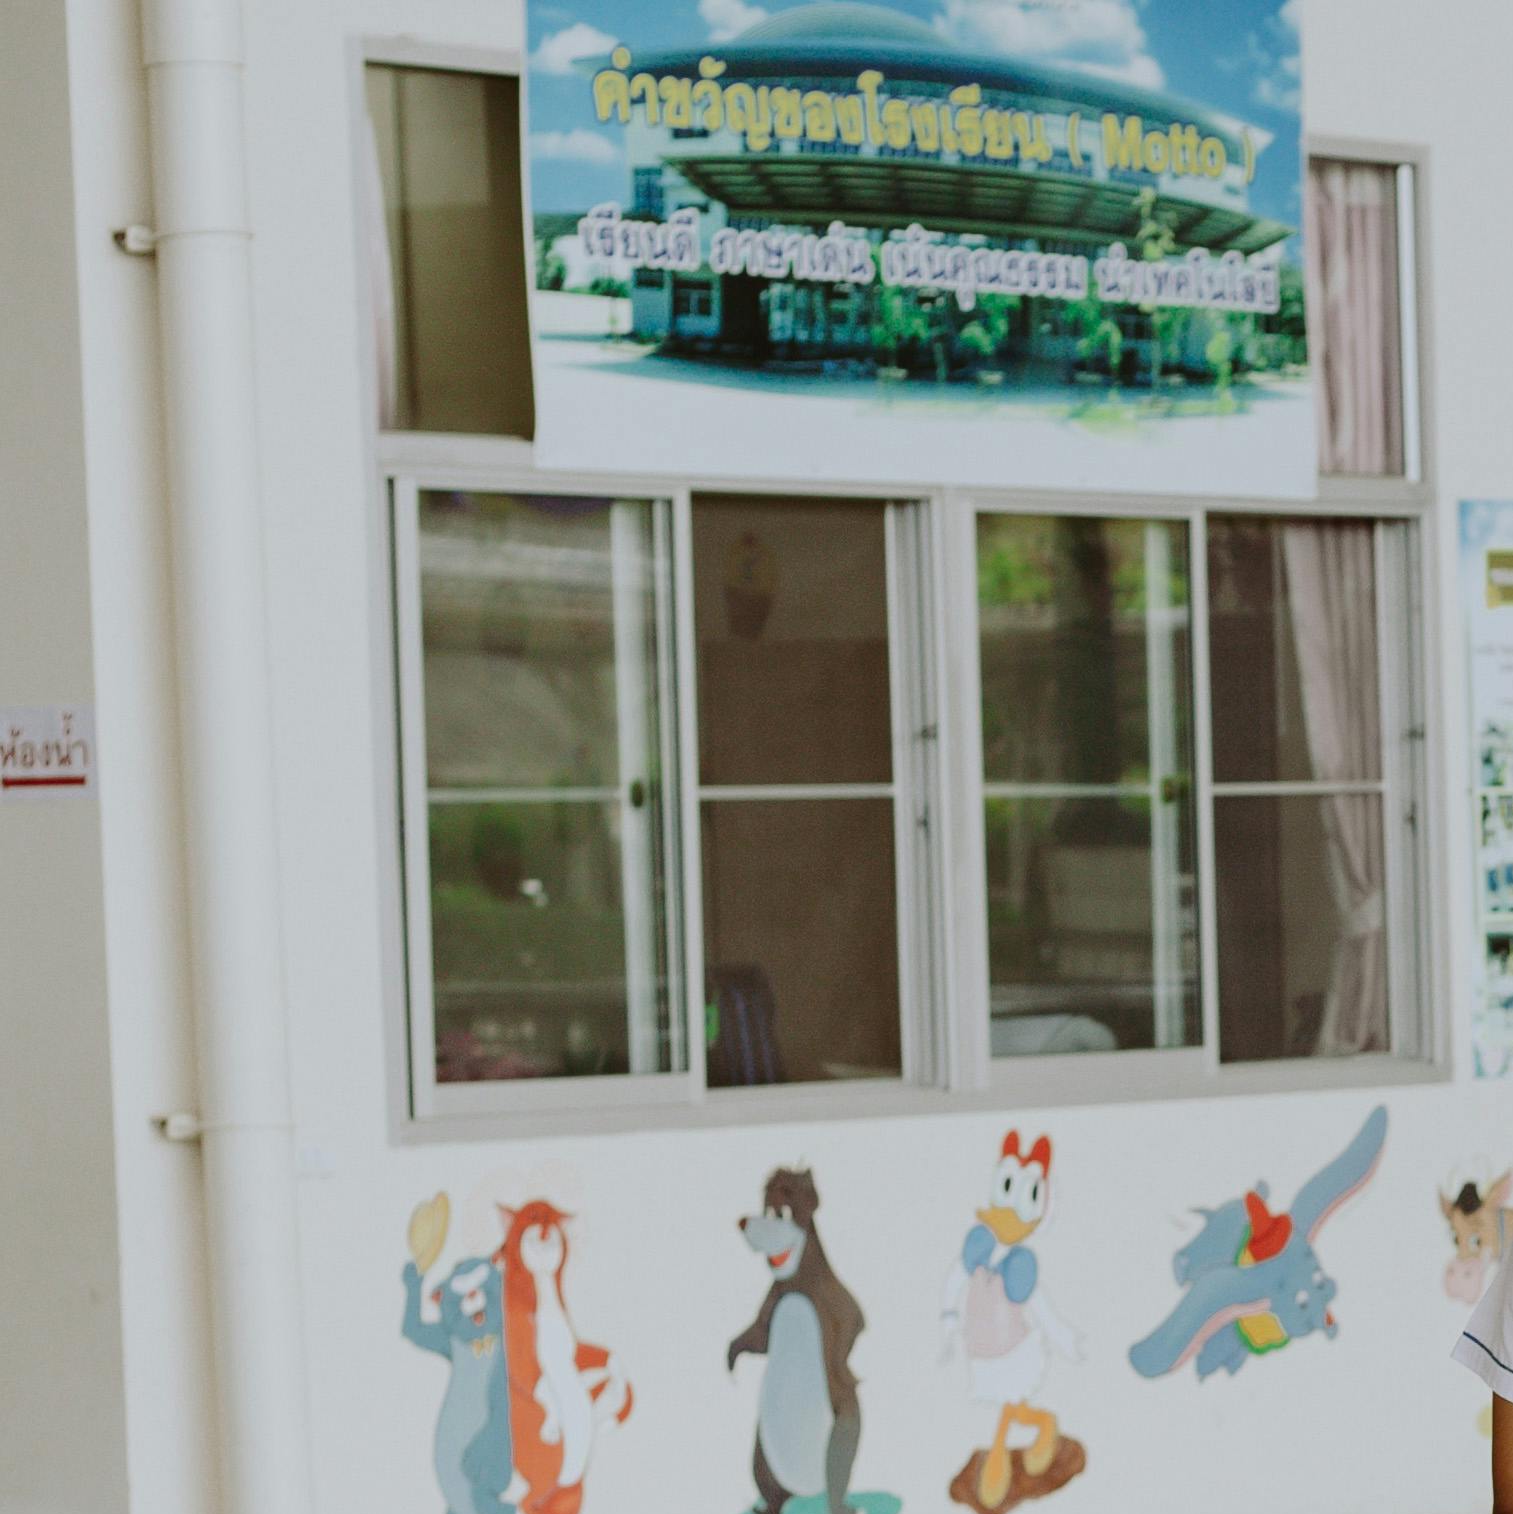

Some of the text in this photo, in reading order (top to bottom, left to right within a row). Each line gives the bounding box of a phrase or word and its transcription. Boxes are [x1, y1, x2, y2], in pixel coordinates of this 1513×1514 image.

[593, 46, 1052, 163] คำขวัญของโรงเรียน
[1101, 112, 1226, 179] Motto
[577, 201, 702, 272] เรียนดี
[709, 220, 876, 284] ภาษาเด่น
